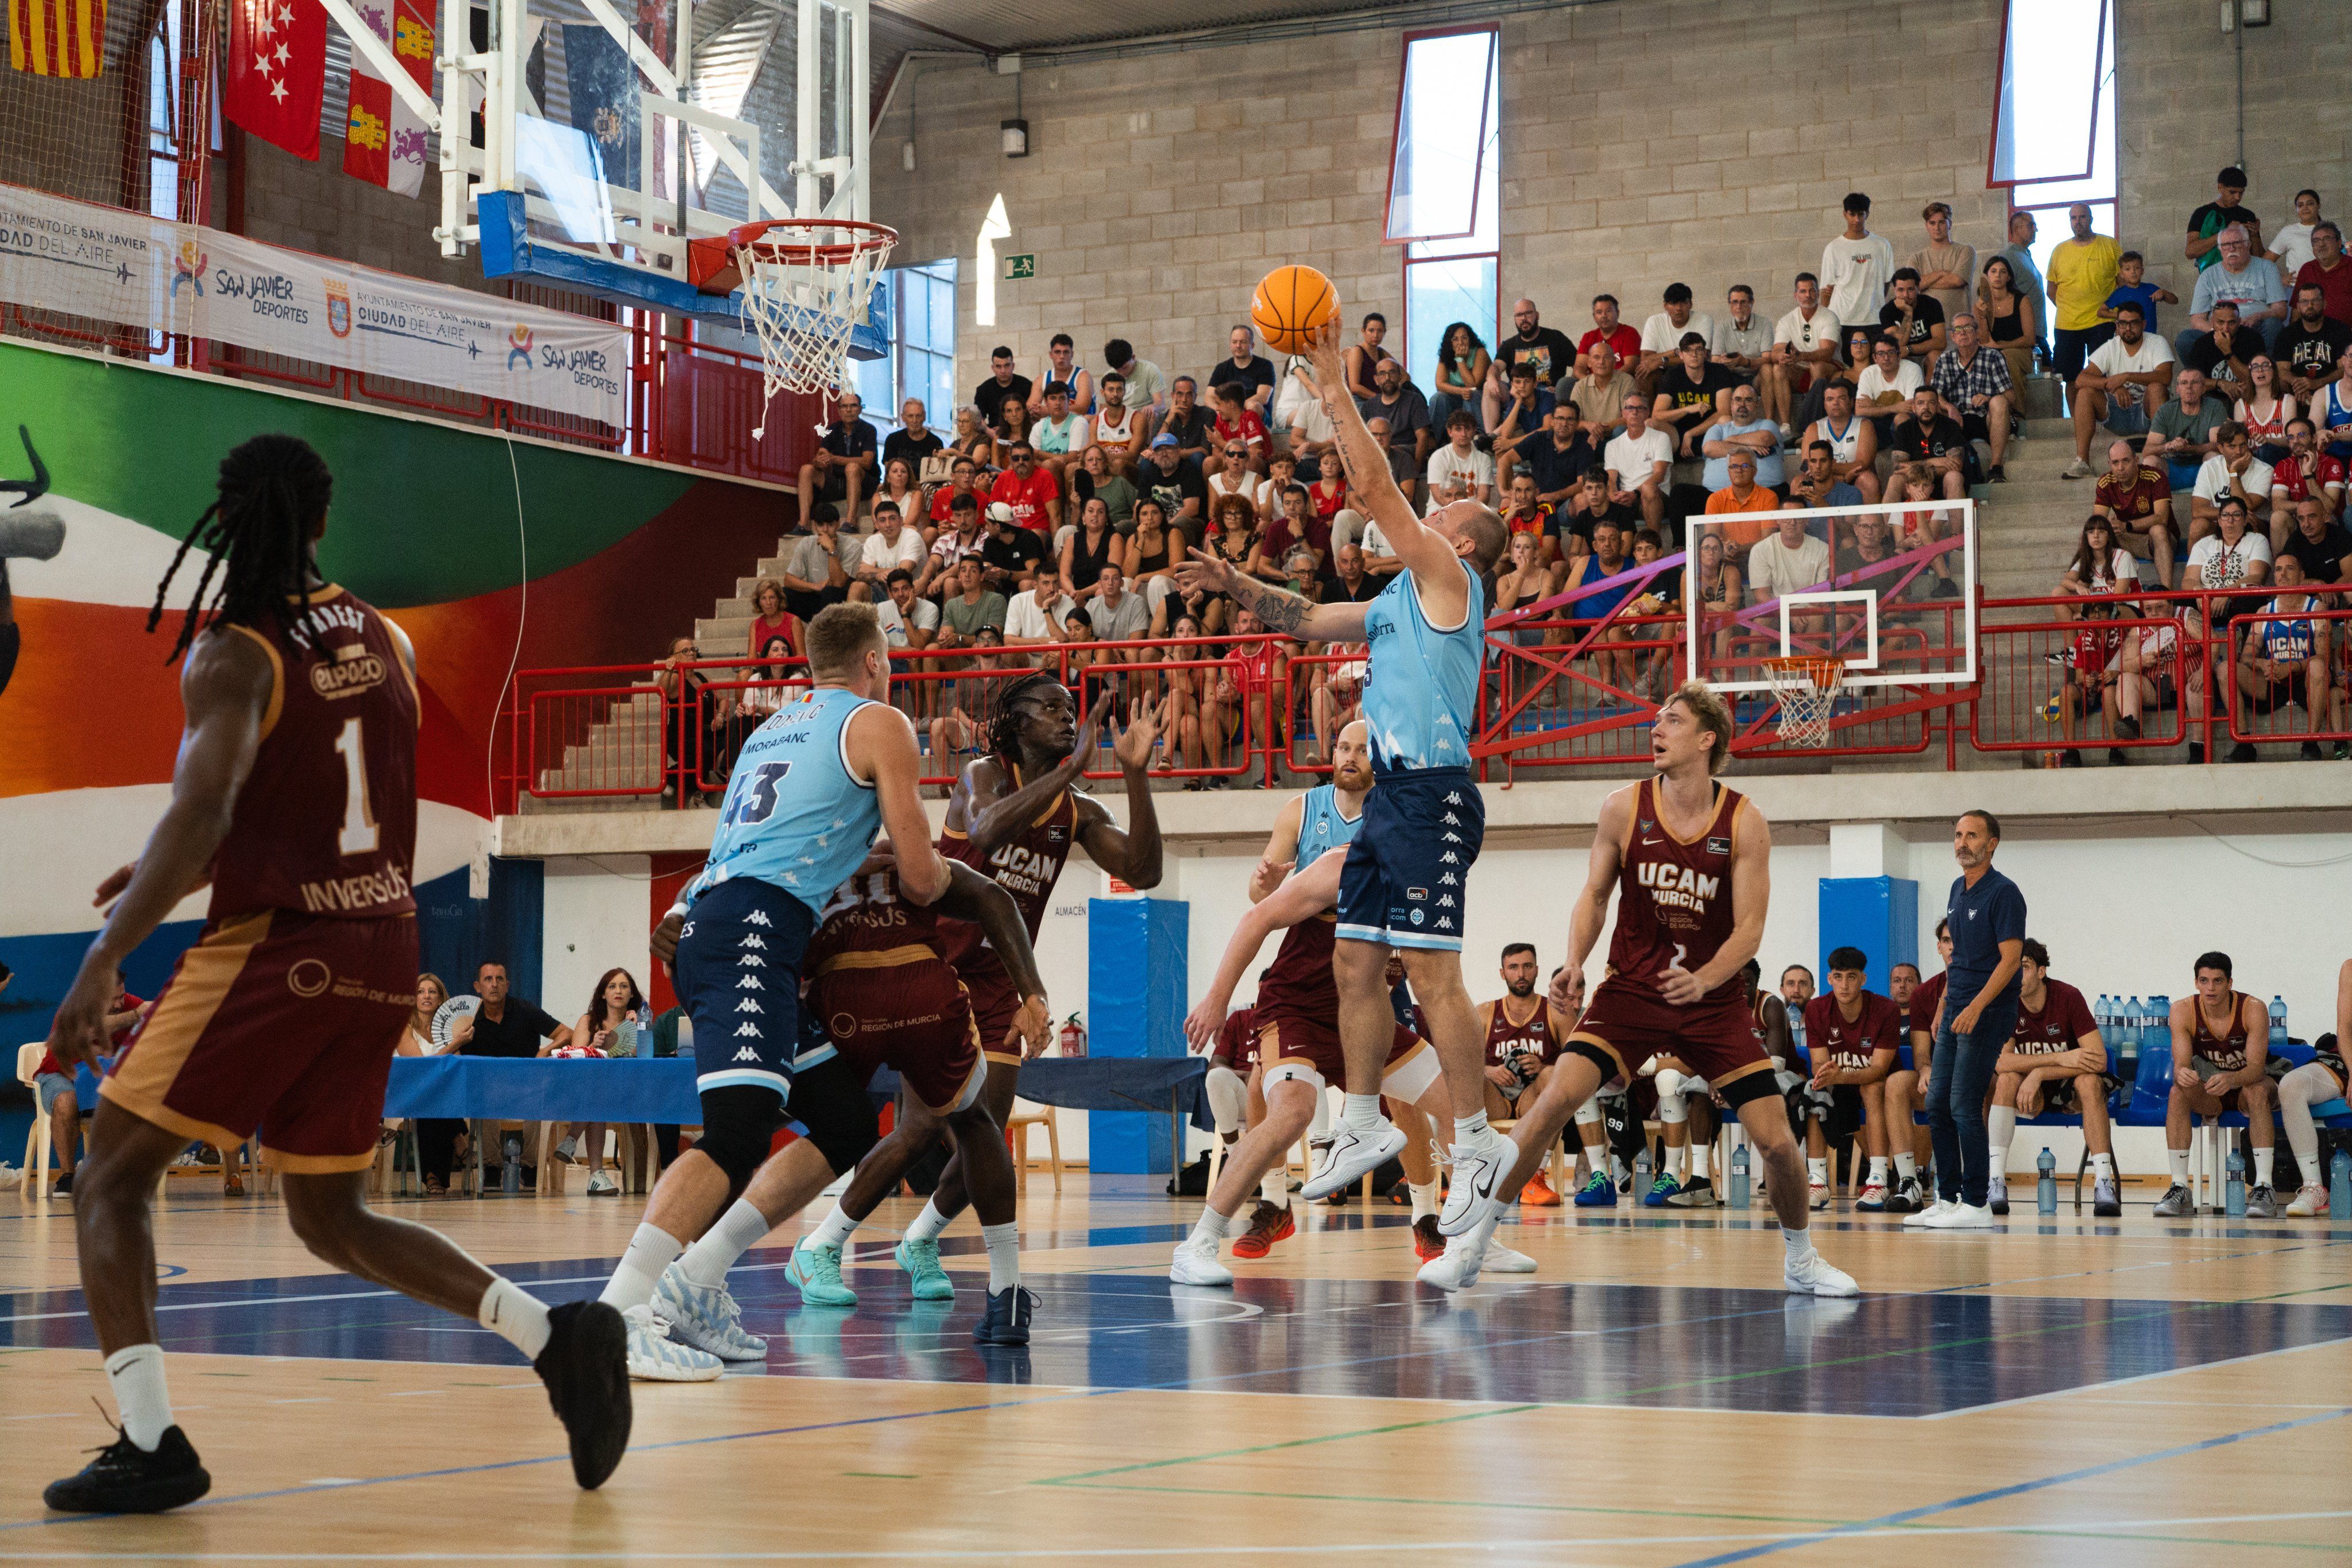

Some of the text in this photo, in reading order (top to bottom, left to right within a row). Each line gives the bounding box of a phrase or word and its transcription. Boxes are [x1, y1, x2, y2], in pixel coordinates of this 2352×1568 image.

[0, 211, 147, 251] TAMIENTO DE SAN JAVIER
[40, 235, 68, 255] DEL
[75, 243, 113, 264] AIRE
[216, 269, 293, 301] SAN JAVIER
[253, 299, 308, 324] DEPORTES
[357, 292, 491, 330] AYUNTAMIENTO DE SAN JAVIER
[358, 307, 466, 342] CIUDAD DEL AIRE
[541, 344, 607, 373] SAN JAVIER
[2292, 340, 2331, 366] HEAT
[574, 371, 618, 396] DEPORTES
[1677, 392, 1711, 404] UCAM
[2266, 637, 2308, 652] UCAM
[2272, 650, 2304, 660] MURCIA
[745, 732, 810, 755] MORABANC
[334, 717, 381, 857] 1
[991, 843, 1058, 884] UCAM
[995, 869, 1040, 897] MURCIA
[1638, 862, 1719, 900] UCAM
[1055, 903, 1086, 917] ALMACÉN
[1651, 889, 1705, 915] MURCIA
[448, 1001, 470, 1014] brillo
[894, 1020, 905, 1028] DE
[907, 1013, 941, 1025] MURCIA
[1495, 1038, 1544, 1058] UCAM
[1607, 1117, 1623, 1132] 99
